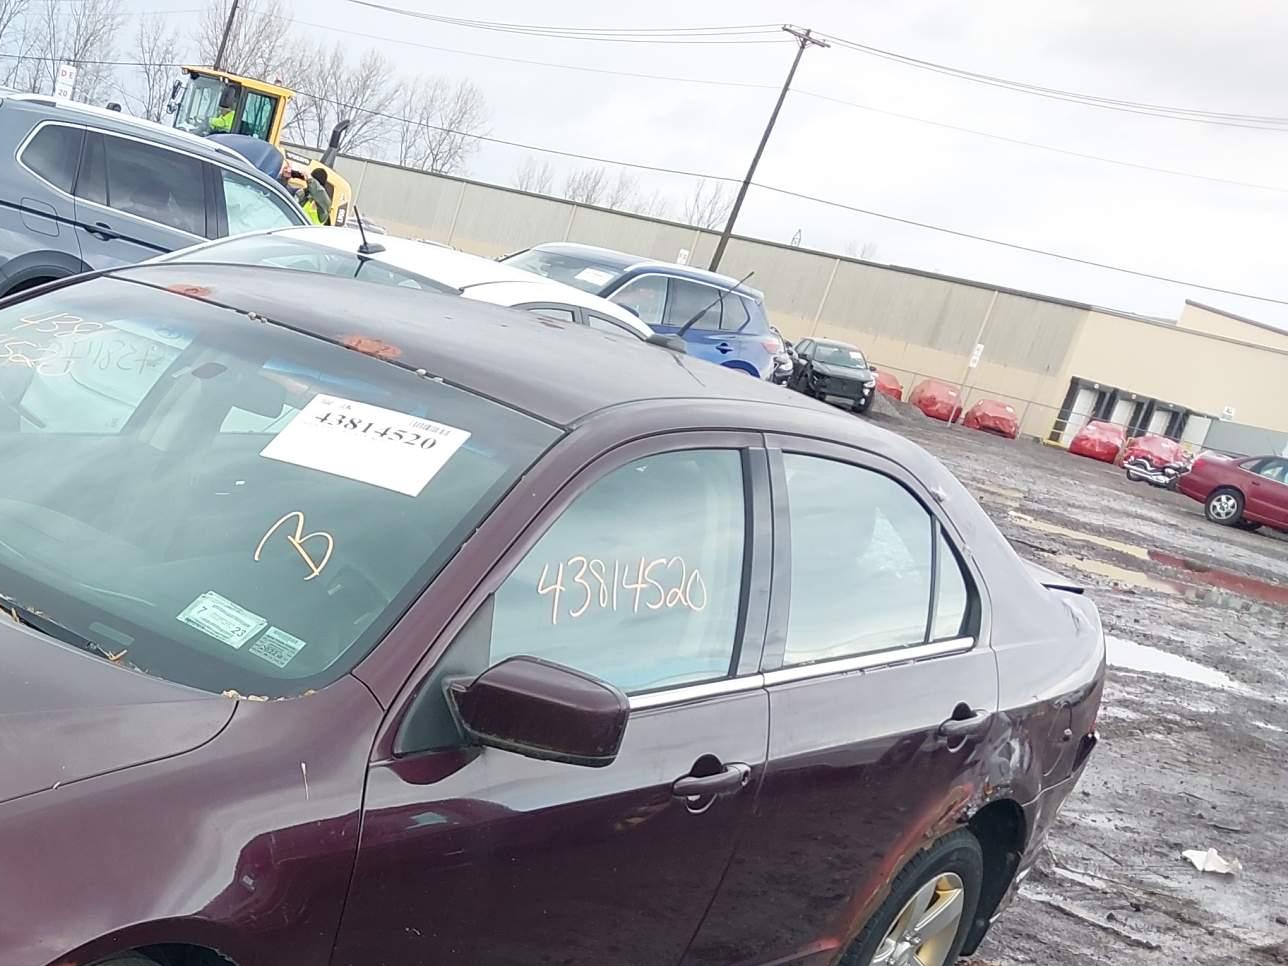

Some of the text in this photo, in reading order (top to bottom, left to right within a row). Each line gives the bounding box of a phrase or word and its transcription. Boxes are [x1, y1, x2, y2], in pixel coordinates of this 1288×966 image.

[315, 412, 438, 450] 43814520
[537, 555, 708, 625] 43814520
[231, 626, 247, 638] 23
